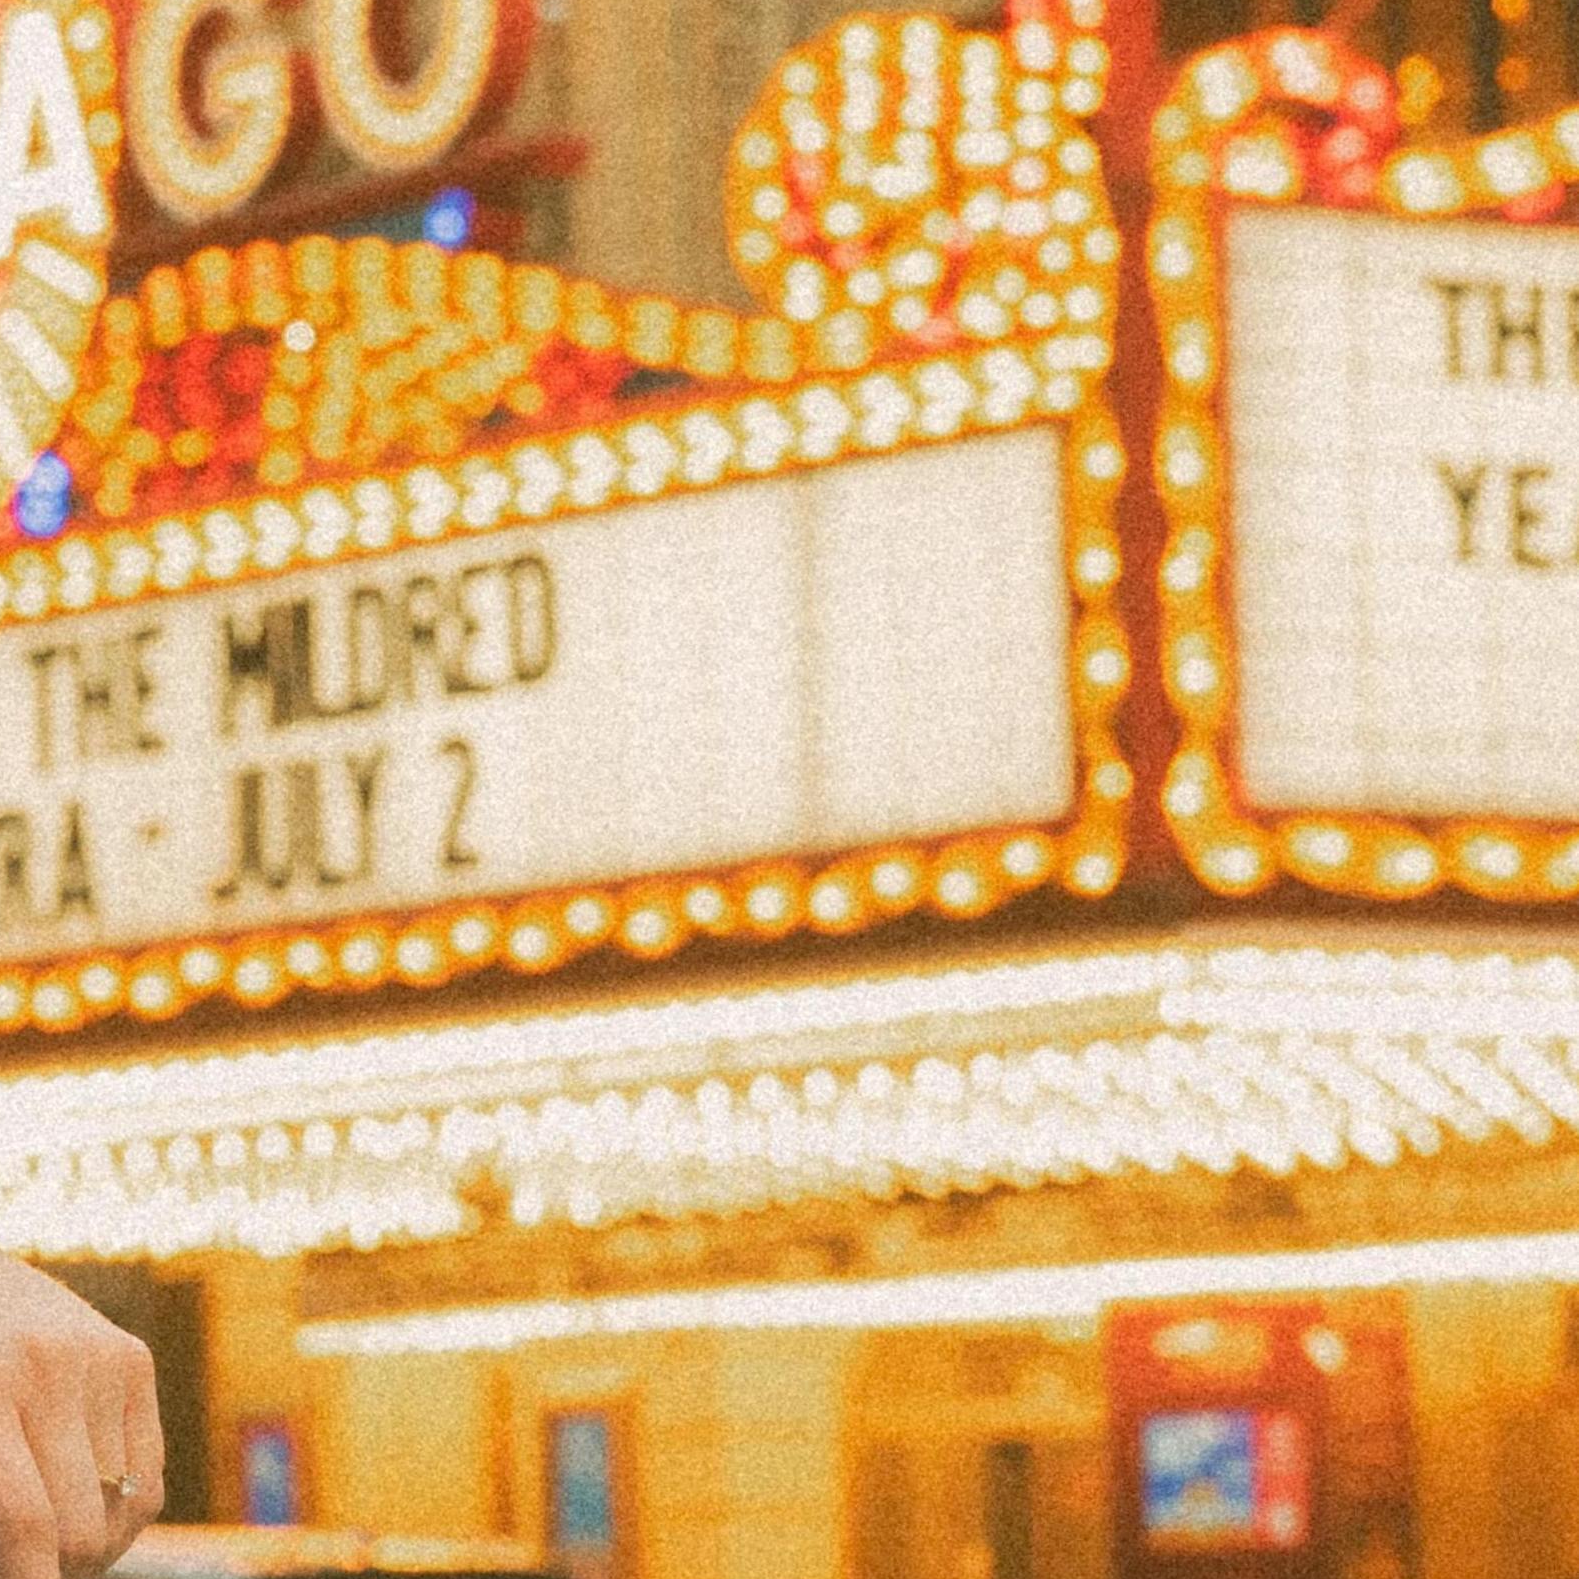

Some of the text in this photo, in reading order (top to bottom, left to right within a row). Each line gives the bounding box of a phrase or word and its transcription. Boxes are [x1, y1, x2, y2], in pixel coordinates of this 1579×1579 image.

[1424, 272, 1579, 388] TH
[1433, 456, 1579, 572] YE
[29, 625, 163, 770] THE
[218, 552, 559, 734] MILDRED
[209, 742, 391, 906] JULY
[439, 736, 479, 866] 2
